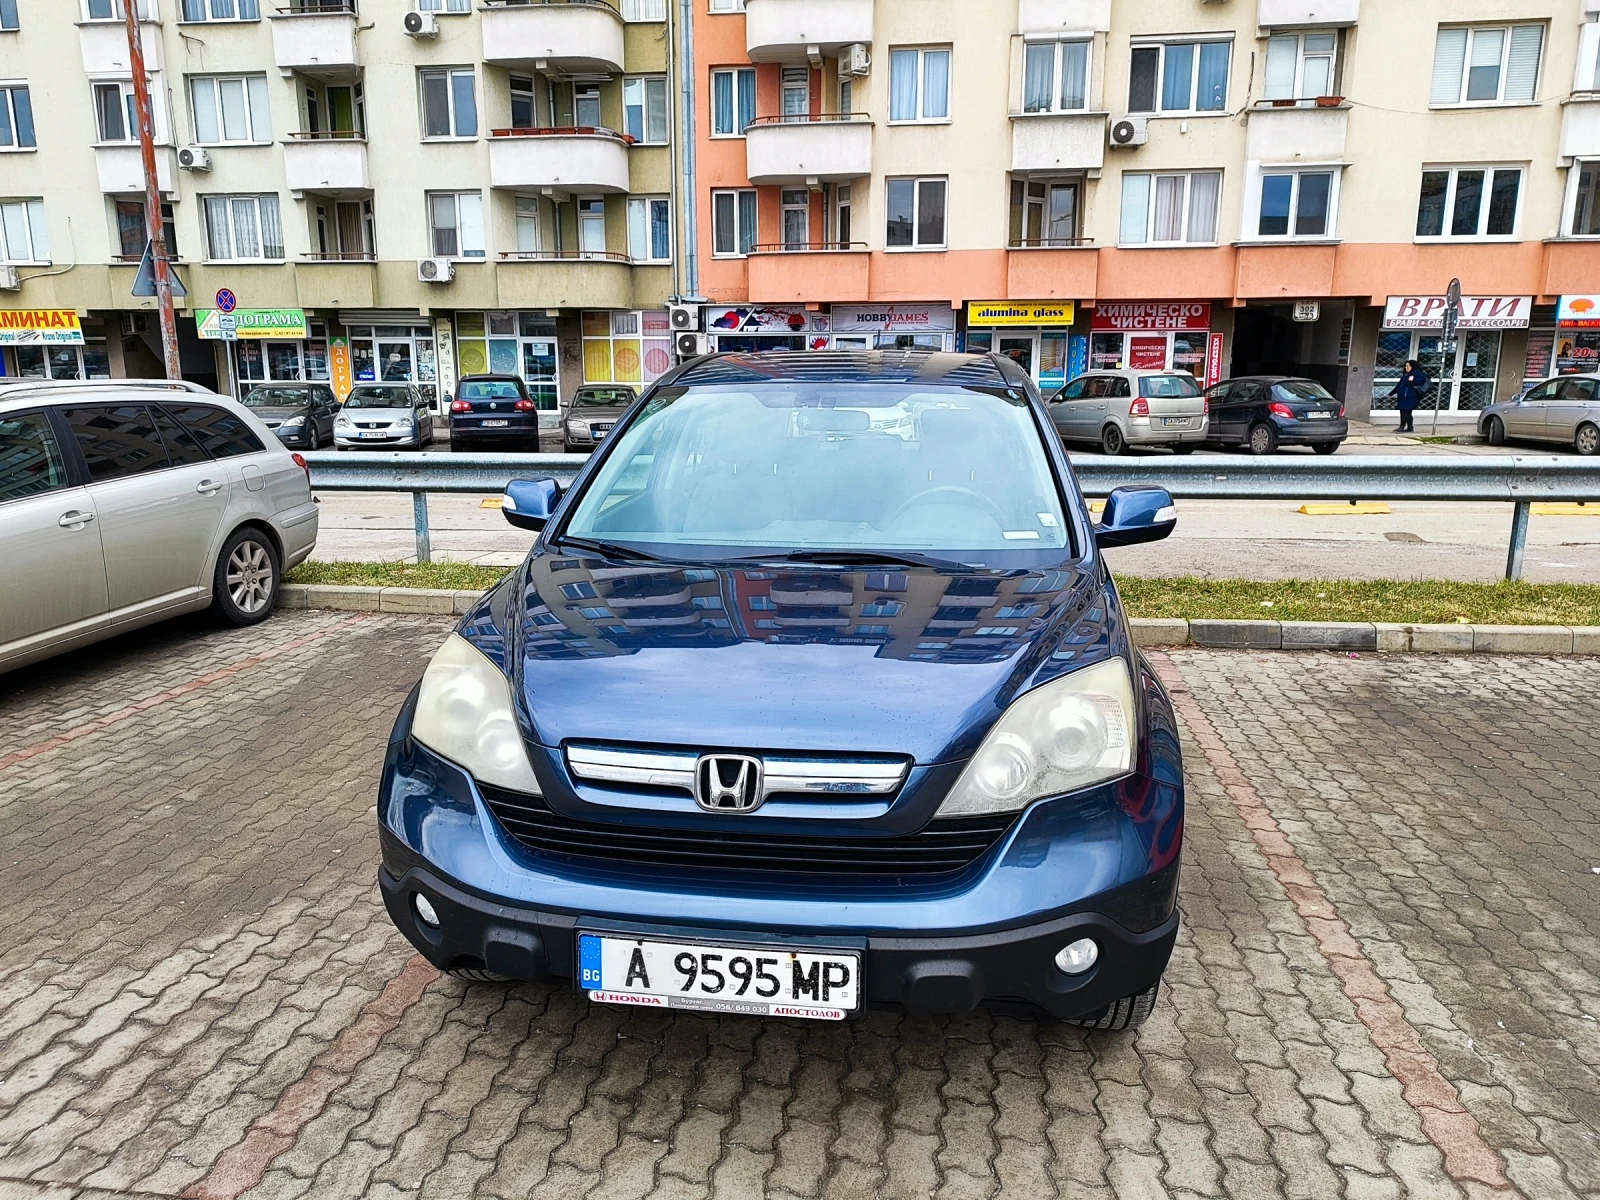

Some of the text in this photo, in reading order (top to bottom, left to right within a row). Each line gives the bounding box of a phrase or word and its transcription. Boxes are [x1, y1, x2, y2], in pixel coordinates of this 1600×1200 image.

[978, 308, 1064, 318] alumina glass
[1096, 305, 1203, 317] ХИМИЧЕСКО
[0, 311, 76, 328] МИНАТ
[236, 314, 302, 326] ДОГРАМА
[1111, 317, 1187, 328] ЧИСТЕНЕ
[582, 968, 600, 981] BG
[624, 947, 850, 1001] A 9595 MP
[609, 994, 662, 1005] HONDA
[715, 1003, 734, 1011] 056/
[735, 1004, 751, 1012] 849
[774, 1006, 841, 1018] АПОСТОЛОВ
